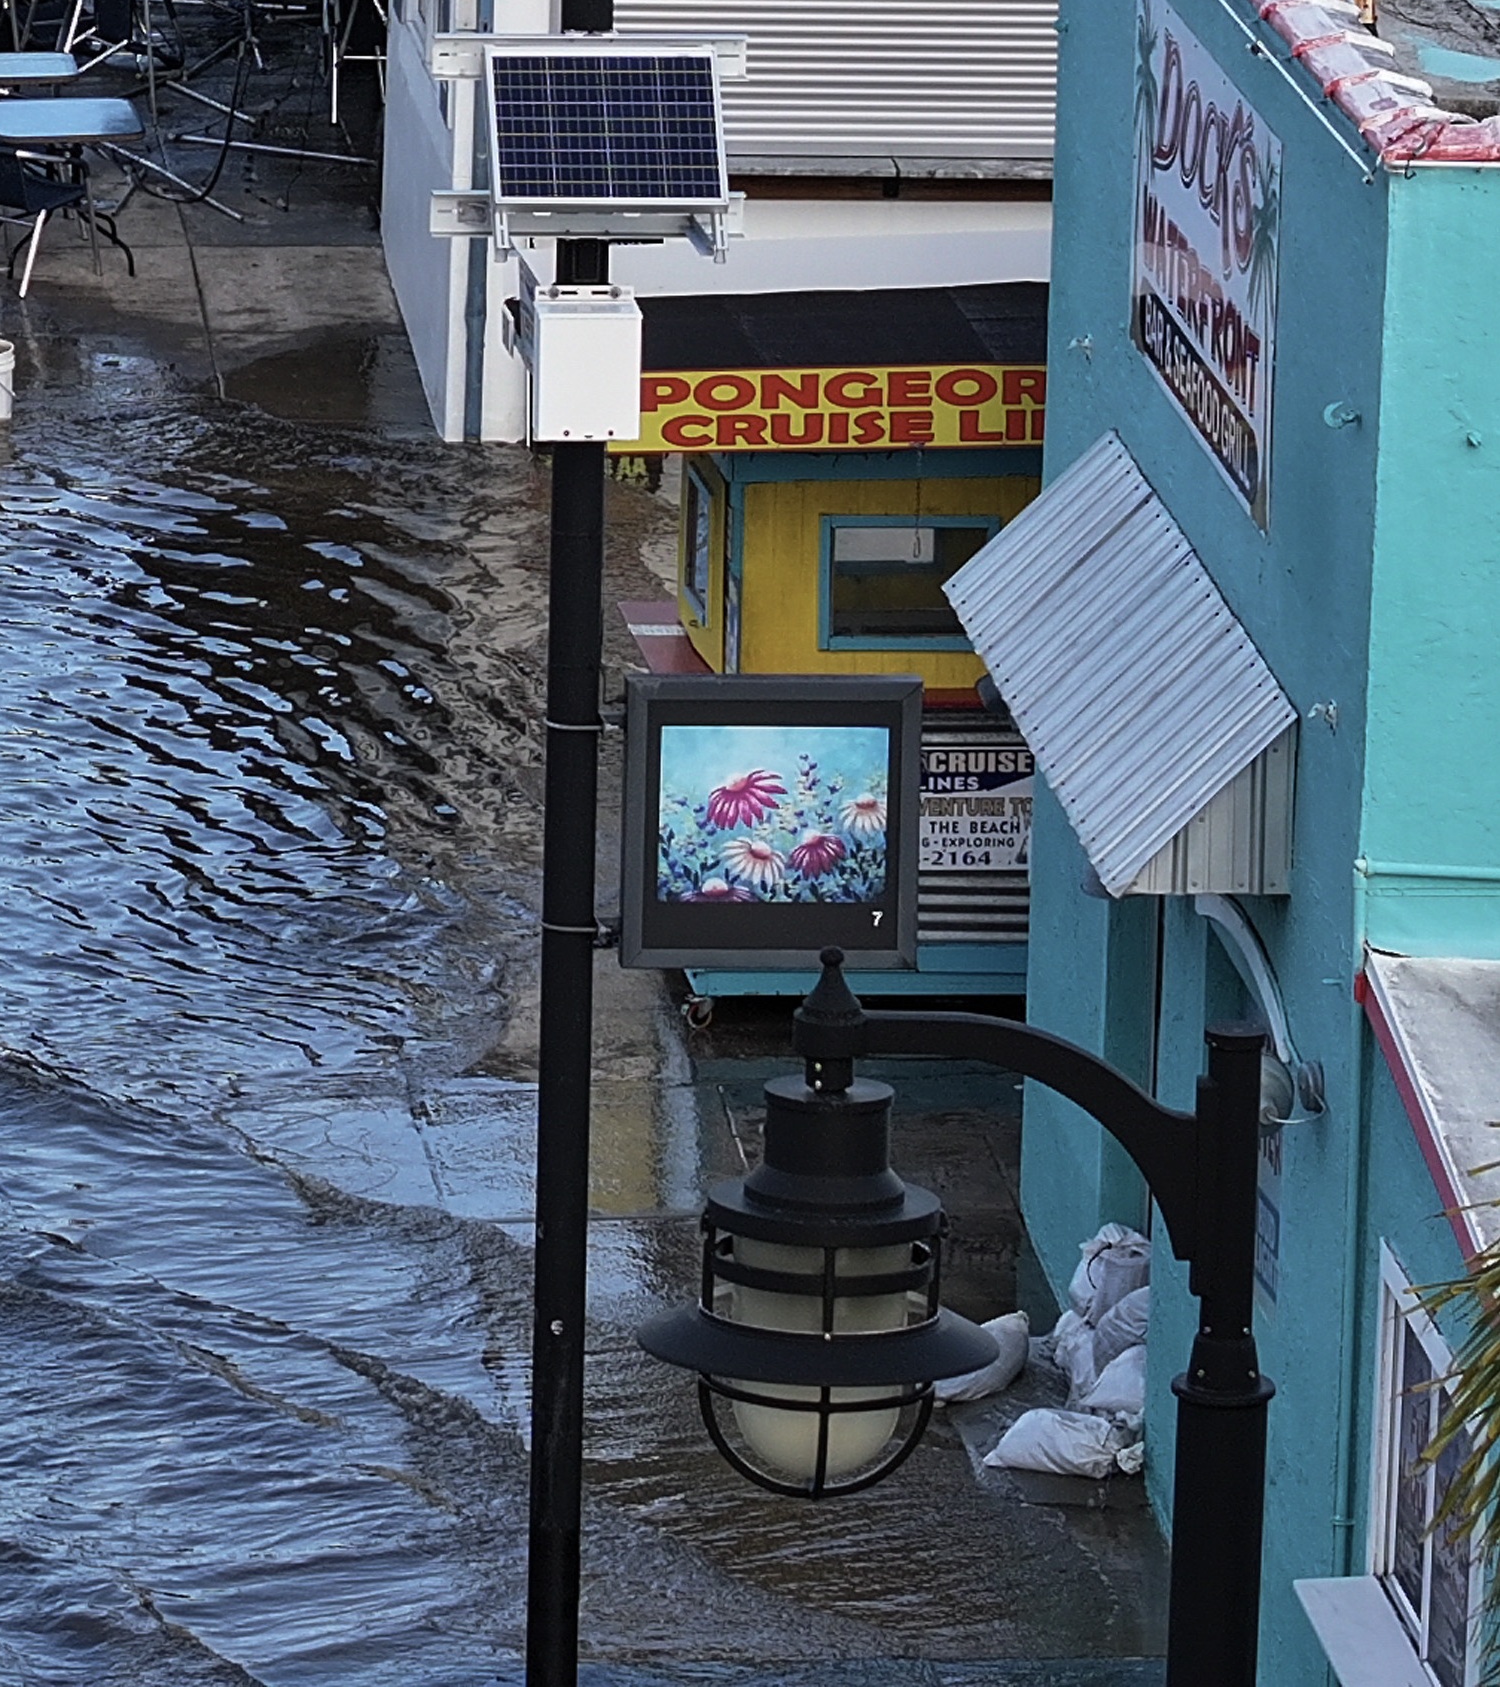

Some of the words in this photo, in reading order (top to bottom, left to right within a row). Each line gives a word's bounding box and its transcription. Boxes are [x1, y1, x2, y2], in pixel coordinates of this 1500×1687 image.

[1143, 185, 1261, 417] WATERFRONT
[1173, 331, 1220, 448] SEAFOOD
[661, 410, 935, 447] CRUISE
[929, 752, 1032, 773] CRUISE
[930, 820, 959, 834] THE
[970, 820, 1020, 834] BEACH
[942, 837, 1015, 848] EXPLORING
